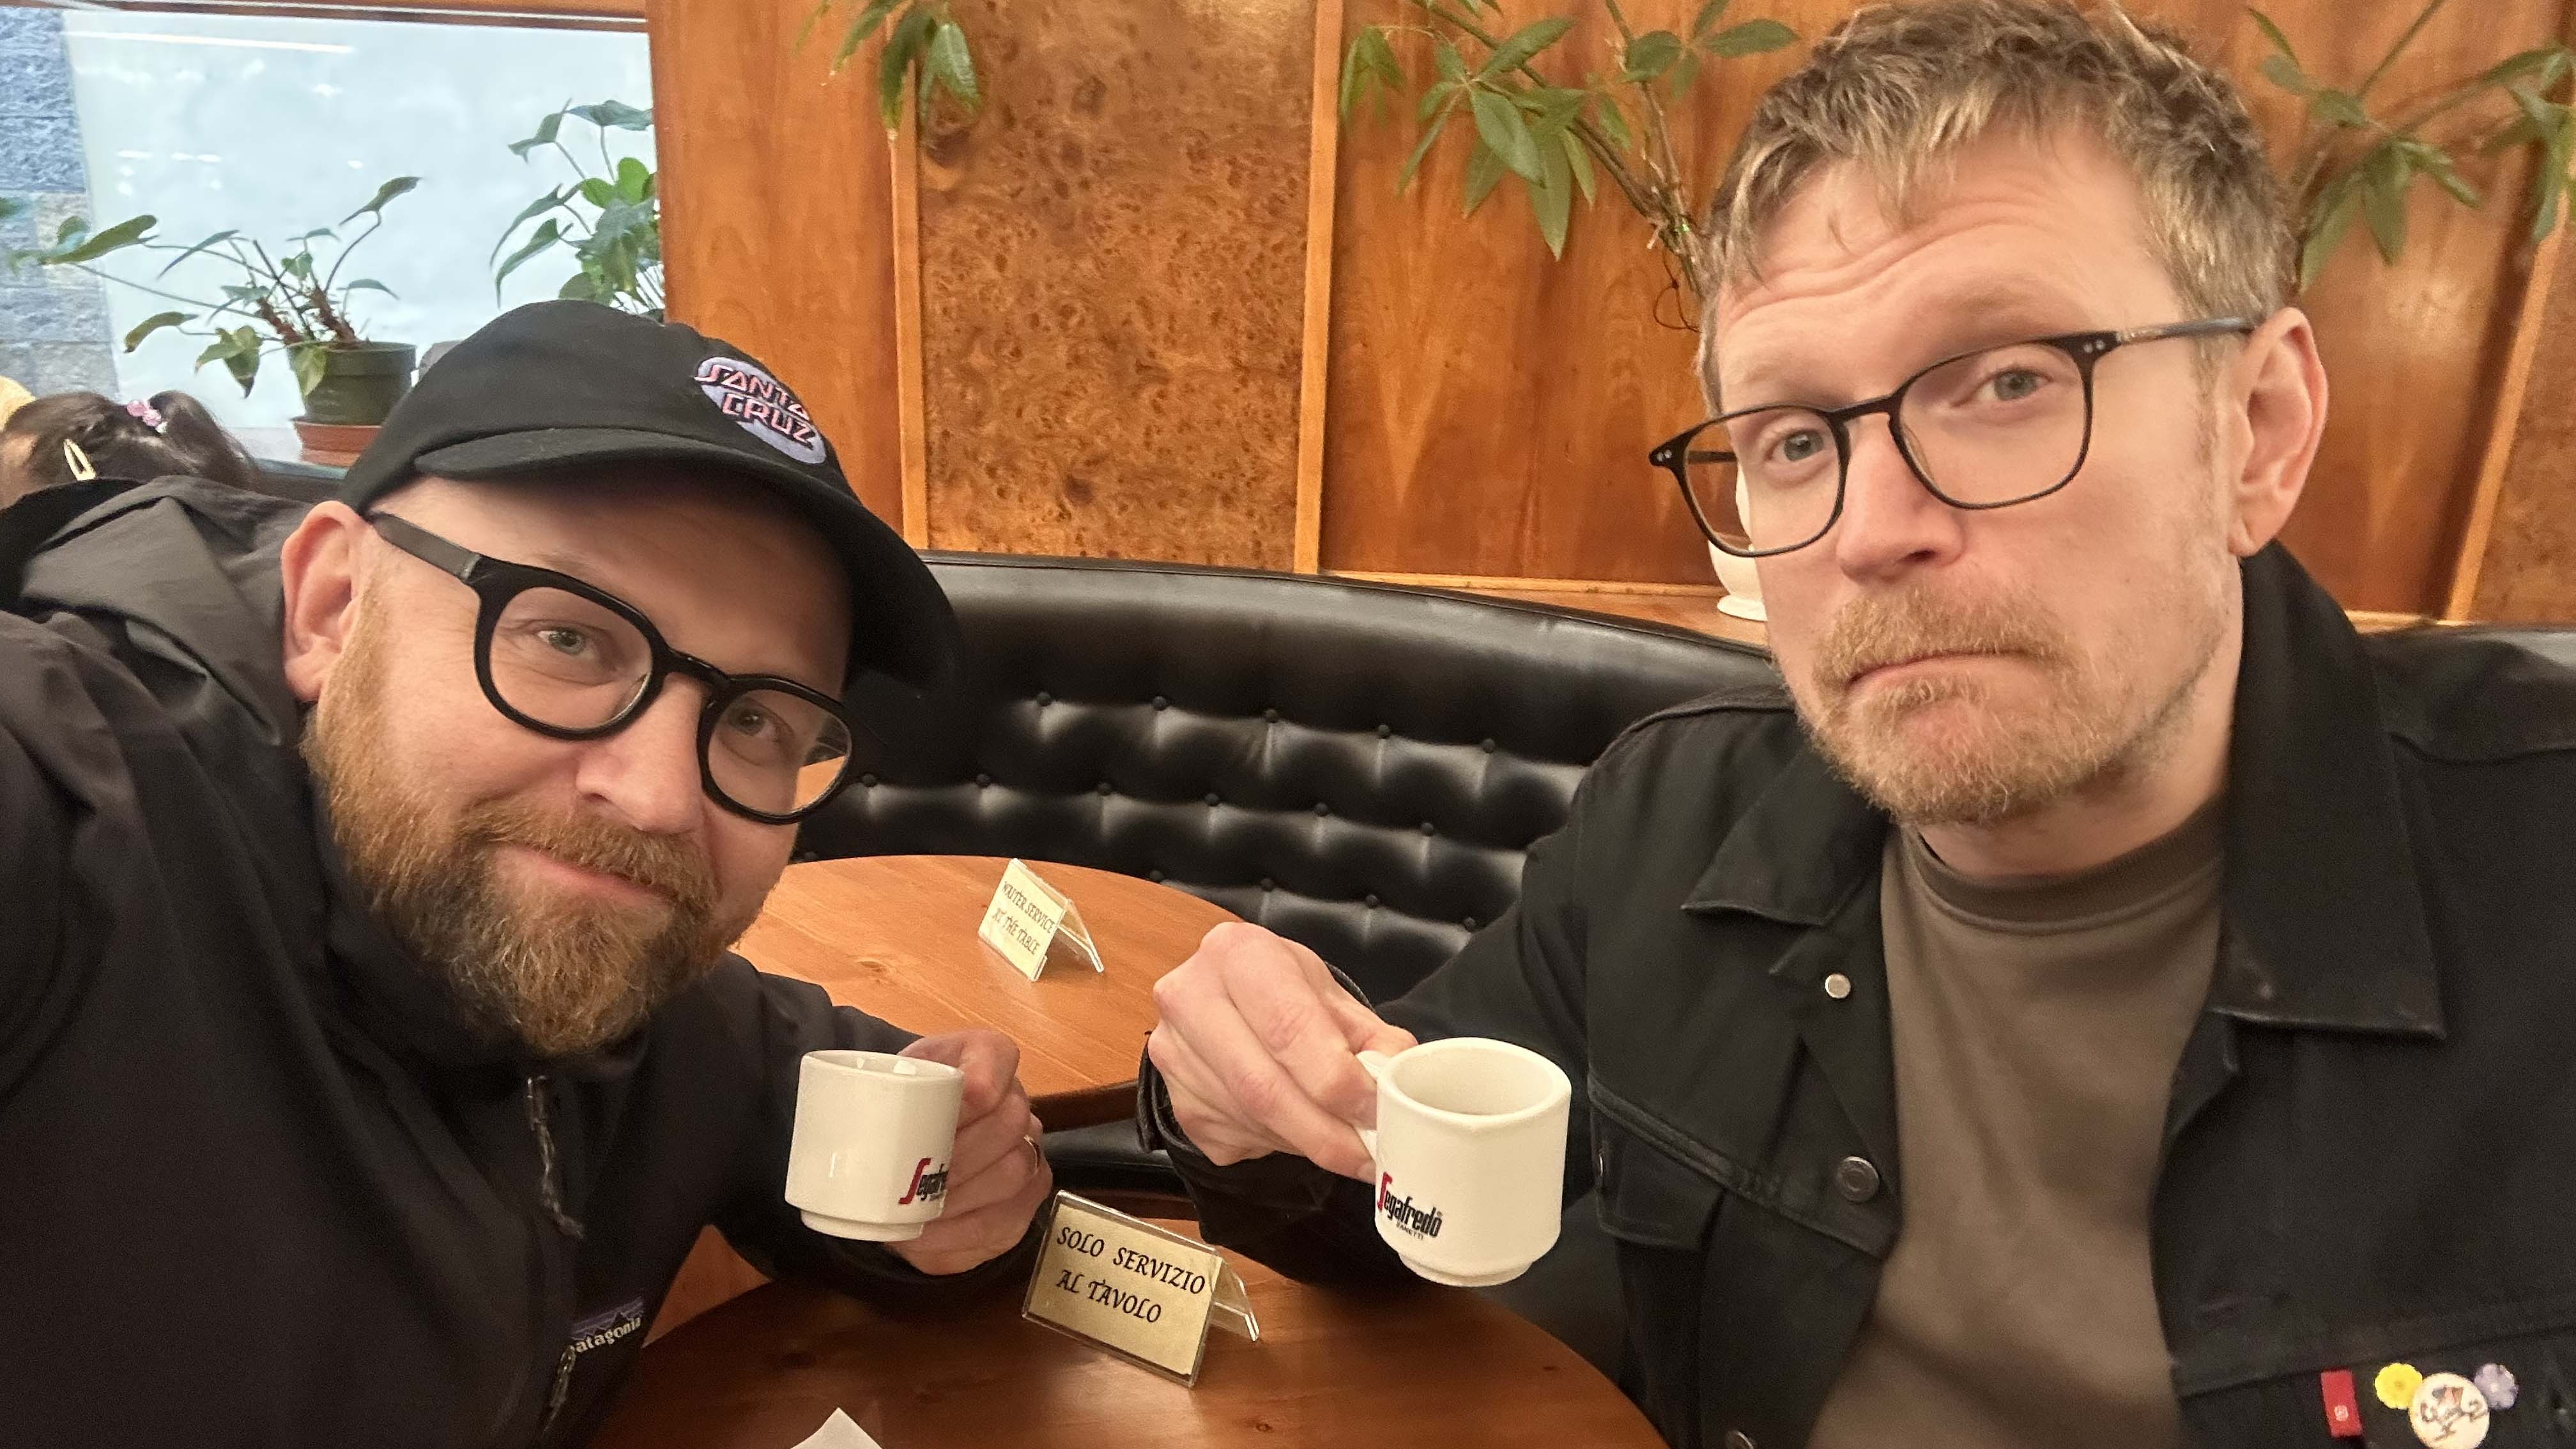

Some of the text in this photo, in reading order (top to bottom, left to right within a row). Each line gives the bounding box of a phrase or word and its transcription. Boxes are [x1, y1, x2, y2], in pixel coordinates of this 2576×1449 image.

[693, 364, 810, 421] SANTA
[722, 393, 815, 445] CRUZ
[992, 907, 1040, 955] AT THE TABLE
[1001, 880, 1055, 934] WAITER SERVICE
[898, 1158, 949, 1204] Segafr
[1377, 1171, 1443, 1238] Segafredo
[1056, 1227, 1206, 1294] SOLO SERVIZIO
[1056, 1269, 1162, 1322] AL TAVOLO
